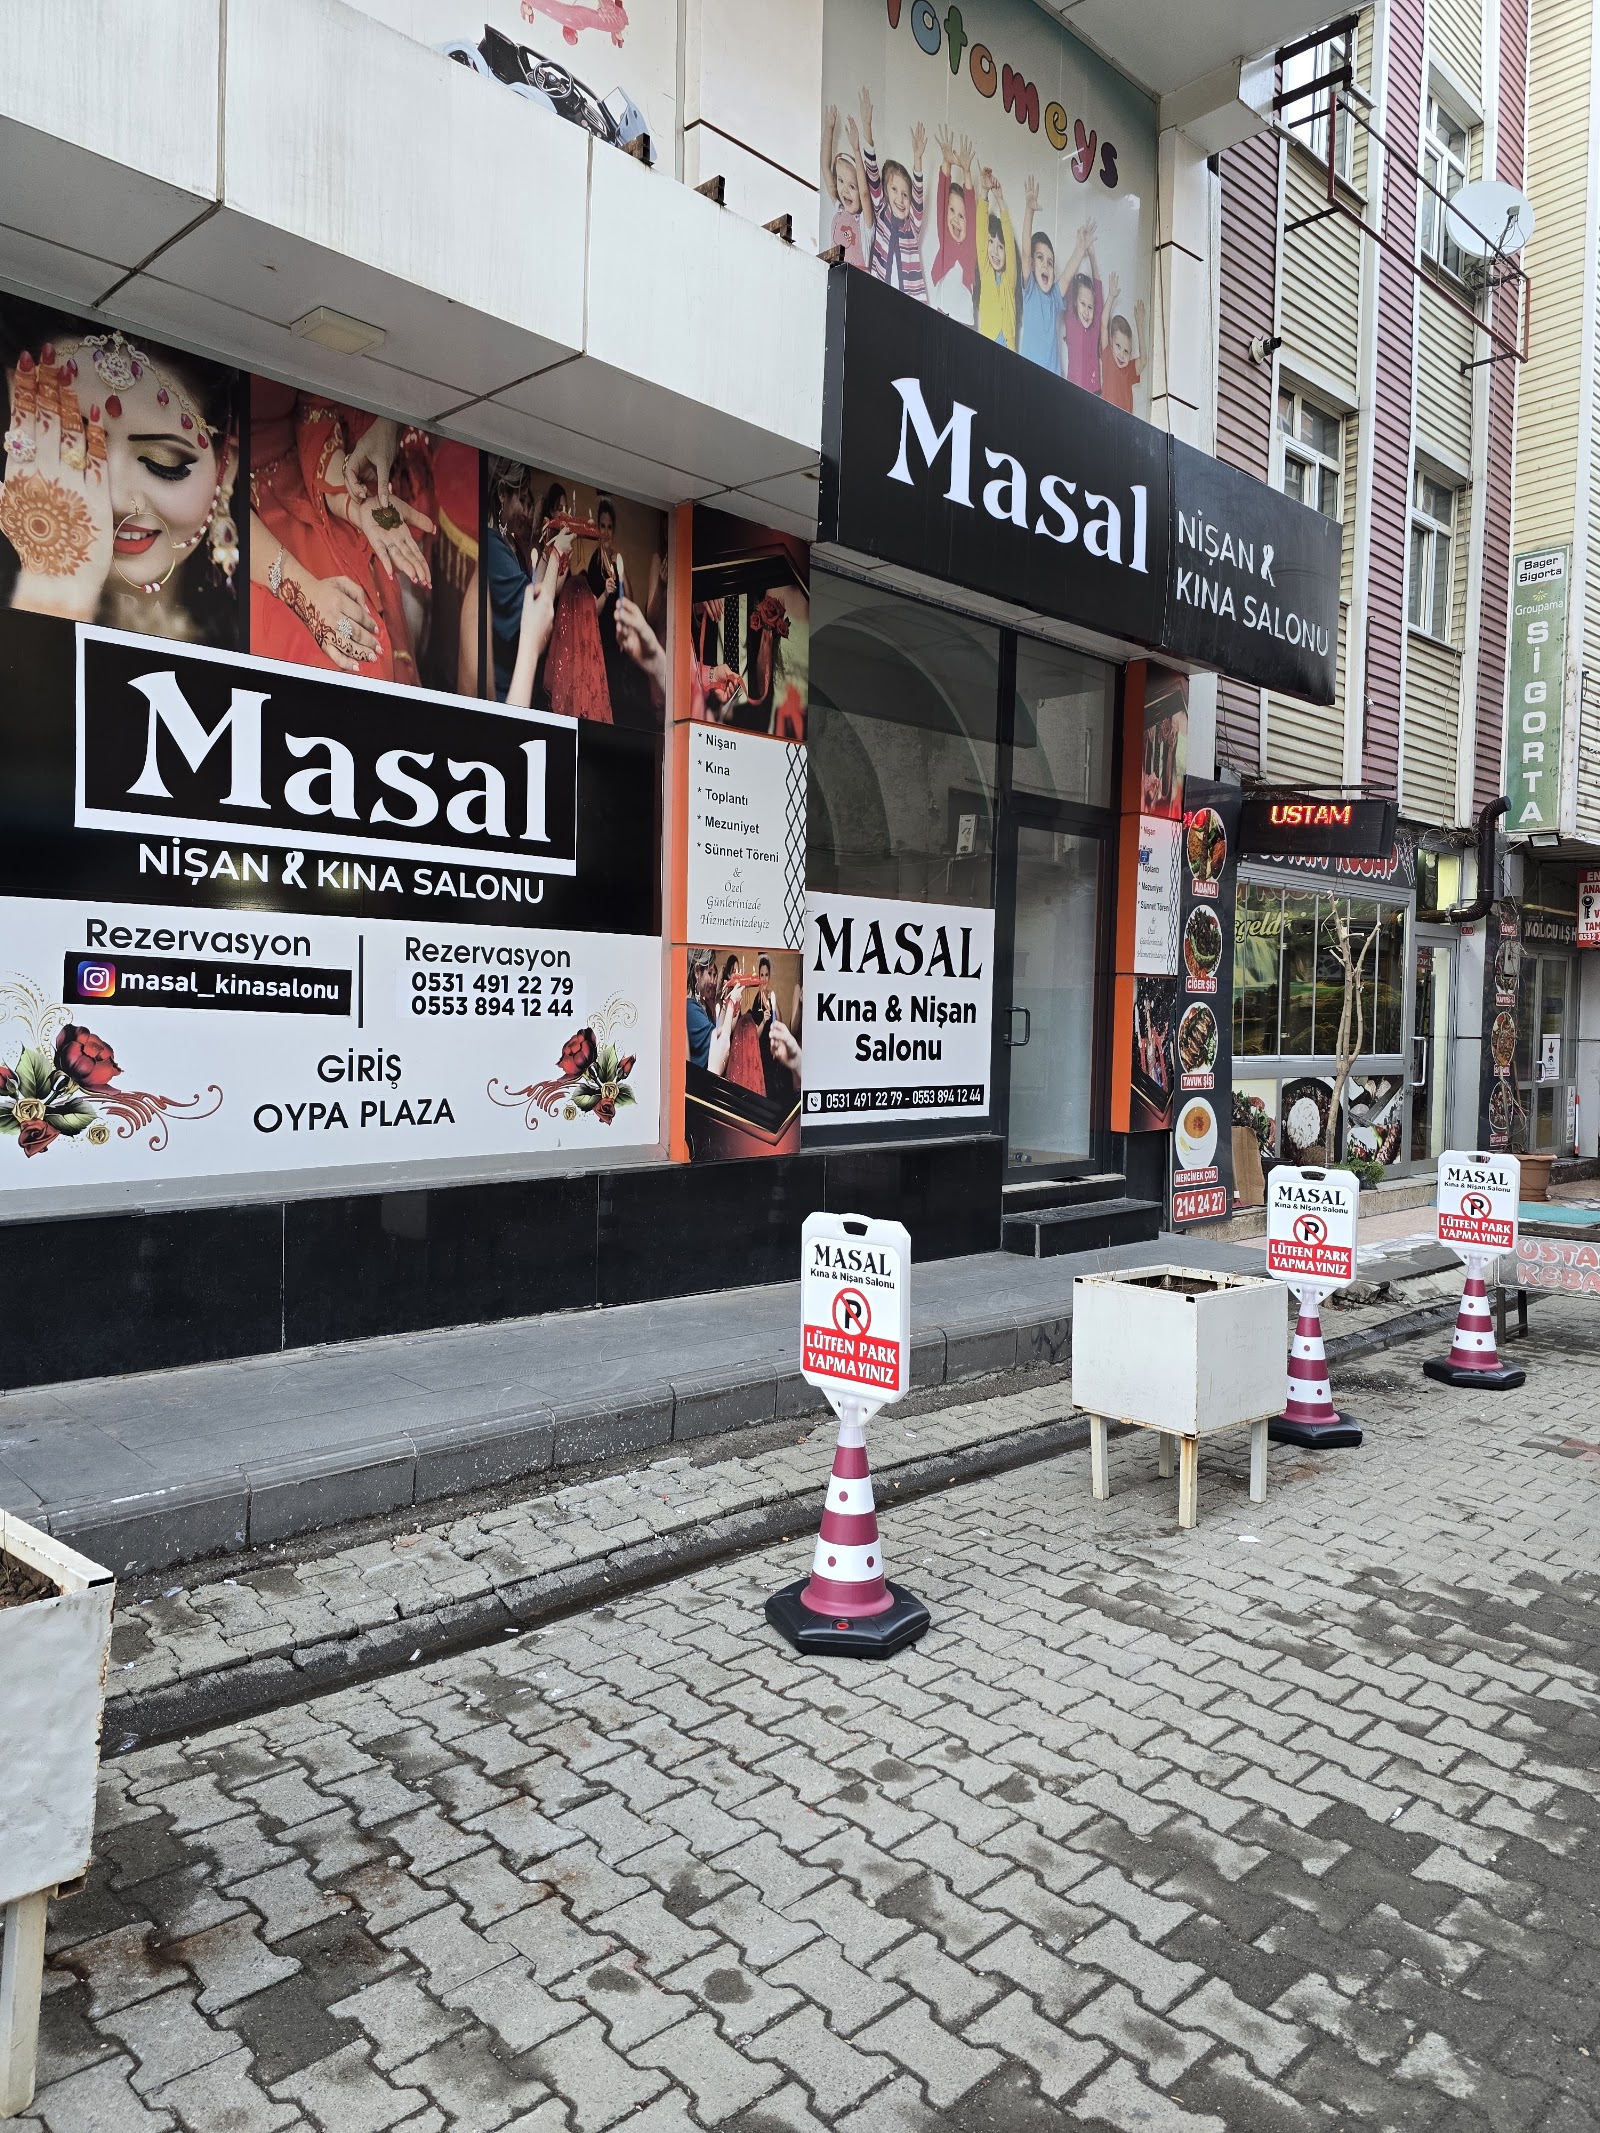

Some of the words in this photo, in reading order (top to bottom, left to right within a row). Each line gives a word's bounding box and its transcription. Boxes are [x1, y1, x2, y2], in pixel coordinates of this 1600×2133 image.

[886, 376, 1149, 574] Masal
[1178, 508, 1254, 575] NİŞAN
[1524, 557, 1559, 570] Bager
[1519, 568, 1562, 582] Sigorta
[1176, 567, 1237, 621] KINA
[1242, 595, 1329, 657] SALONU
[1515, 600, 1564, 616] Groupama
[706, 733, 737, 751] Nişan
[126, 670, 552, 843] Masal
[705, 760, 731, 776] Kına
[704, 788, 748, 806] Toplantı
[705, 815, 760, 835] Mezuniyet
[1270, 804, 1353, 825] USTAM
[704, 842, 743, 859] Sünnet
[746, 847, 779, 863] Töreni
[138, 837, 270, 886] NİŞAN
[281, 851, 308, 889] &
[317, 859, 404, 893] KINA
[412, 868, 545, 904] SALONU
[724, 879, 745, 893] Özel
[1193, 881, 1216, 896] ADANA
[706, 895, 762, 911] Günlerinizde
[86, 918, 311, 961] Rezervasyon
[812, 912, 983, 980] MASAL
[405, 936, 571, 972] Rezervasyon
[120, 971, 339, 1000] masal_kinasalonu
[411, 971, 464, 993] 0531
[472, 973, 509, 994] 491
[517, 975, 542, 995] 22
[550, 976, 574, 996] 79
[411, 995, 468, 1016] 0553
[474, 996, 515, 1016] 894
[521, 998, 542, 1017] 12
[547, 998, 574, 1017] 44
[817, 993, 877, 1022] Kına
[885, 994, 902, 1023] &
[910, 995, 977, 1029] Nişan
[855, 1033, 942, 1062] Salonu
[316, 1047, 402, 1089] GİRİŞ
[1183, 1075, 1202, 1088] TAVUK
[826, 1093, 850, 1109] 0531
[854, 1092, 872, 1107] 491
[875, 1092, 888, 1106] 22
[890, 1091, 903, 1106] 79
[912, 1090, 935, 1105] 0553
[937, 1089, 955, 1104] 894
[957, 1088, 968, 1103] 12
[969, 1088, 981, 1102] 44
[253, 1100, 349, 1134] OYPA
[360, 1097, 456, 1129] PLAZA
[1447, 1167, 1509, 1187] MASAL
[1278, 1185, 1346, 1206] MASAL
[1466, 1183, 1486, 1191] Nişan
[1487, 1185, 1511, 1193] Salonu
[1176, 1195, 1195, 1217] 214
[1197, 1193, 1210, 1213] 24
[1211, 1191, 1224, 1212] 27
[1274, 1201, 1291, 1209] Kına
[1299, 1204, 1321, 1212] Nişan
[1322, 1205, 1349, 1215] Salonu
[1440, 1216, 1478, 1230] LÜTFEN
[1481, 1221, 1512, 1234] PARK
[1441, 1227, 1510, 1245] YAPMAYINIZ
[814, 1243, 892, 1277] MASAL
[1271, 1242, 1313, 1259] LÜTFEN
[1316, 1248, 1350, 1263] PARK
[1272, 1256, 1348, 1276] YAPMAYINIZ
[810, 1267, 830, 1279] Kına
[831, 1271, 838, 1280] &
[840, 1271, 864, 1285] Nişan
[865, 1277, 895, 1290] Salonu
[806, 1330, 855, 1355] LÜTFEN
[859, 1342, 897, 1364] PARK
[807, 1351, 895, 1385] YAPMAYINIZ
